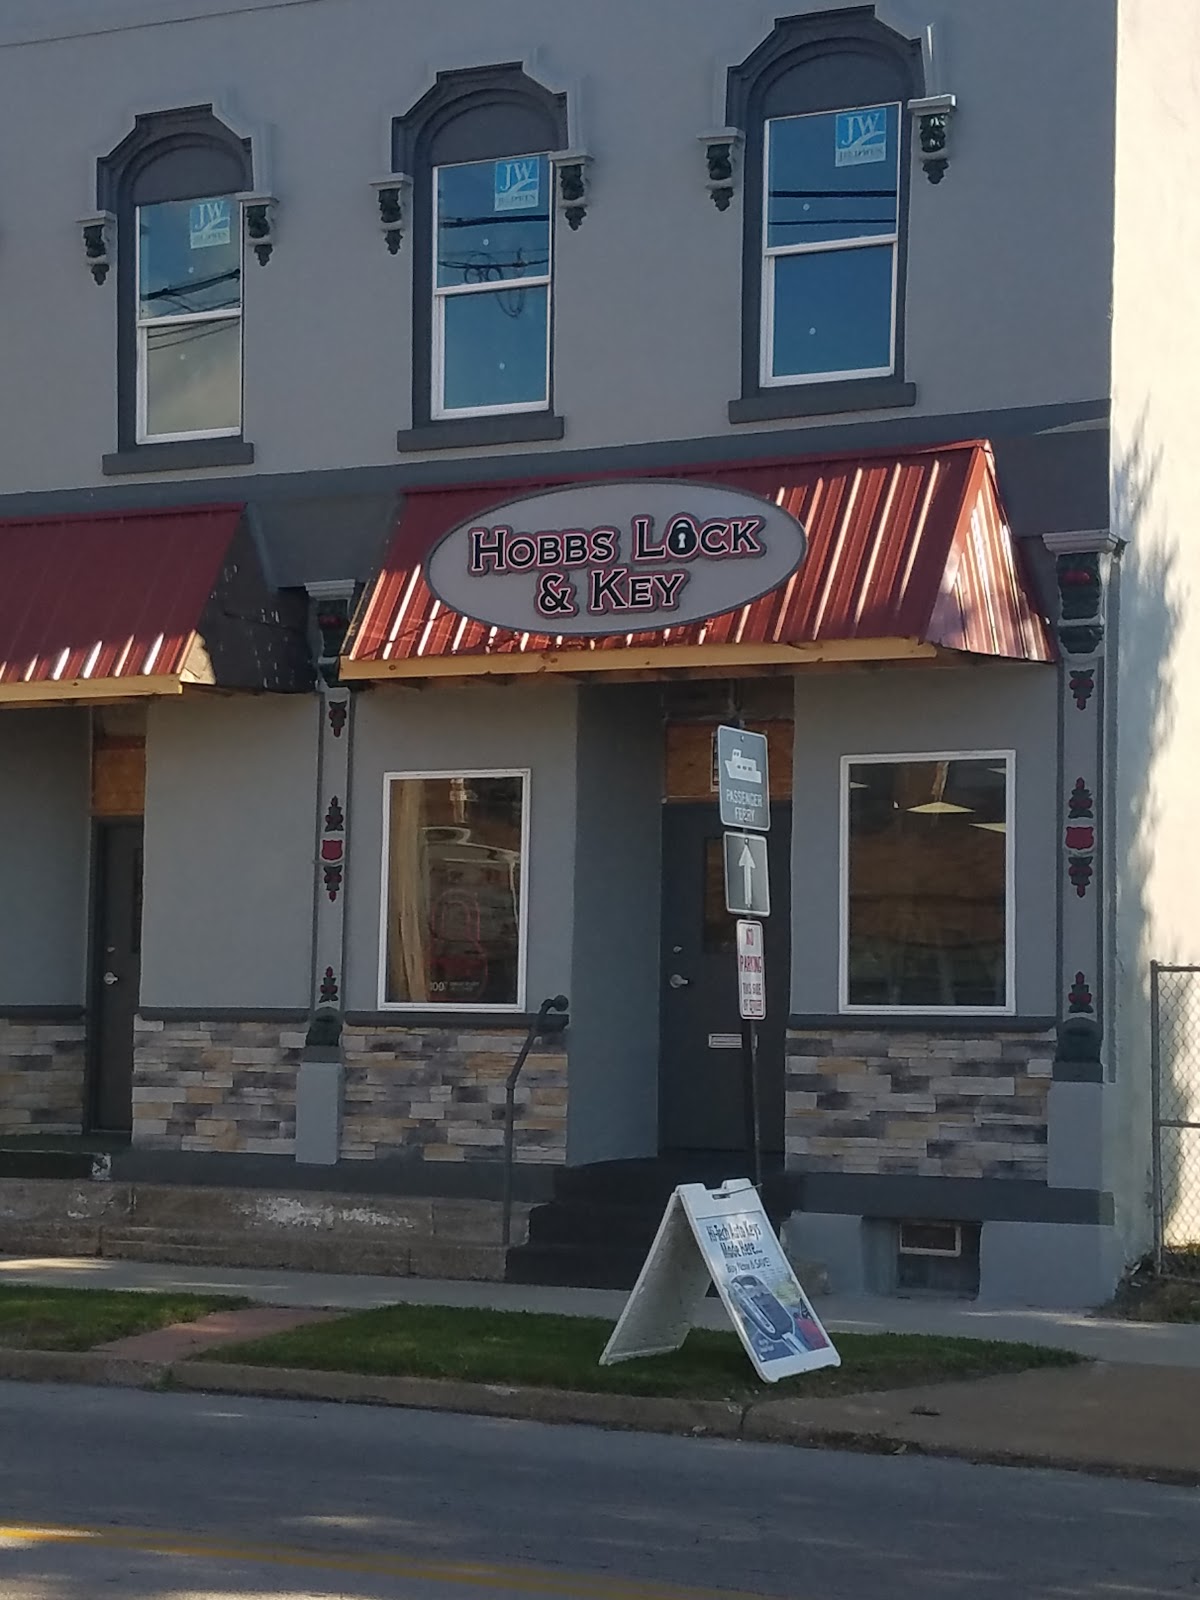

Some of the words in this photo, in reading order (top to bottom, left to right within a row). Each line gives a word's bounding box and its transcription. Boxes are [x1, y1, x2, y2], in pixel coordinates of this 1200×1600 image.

[469, 527, 617, 574] HOBBS
[632, 515, 765, 562] LOCK
[538, 572, 576, 615] &
[590, 568, 687, 612] KEY
[726, 788, 763, 808] PASSENGER
[735, 807, 755, 823] FERRY
[746, 928, 754, 946] NO
[740, 955, 762, 973] PARKING
[728, 1222, 746, 1239] Auto
[743, 1221, 761, 1241] Keys
[720, 1241, 742, 1258] Made
